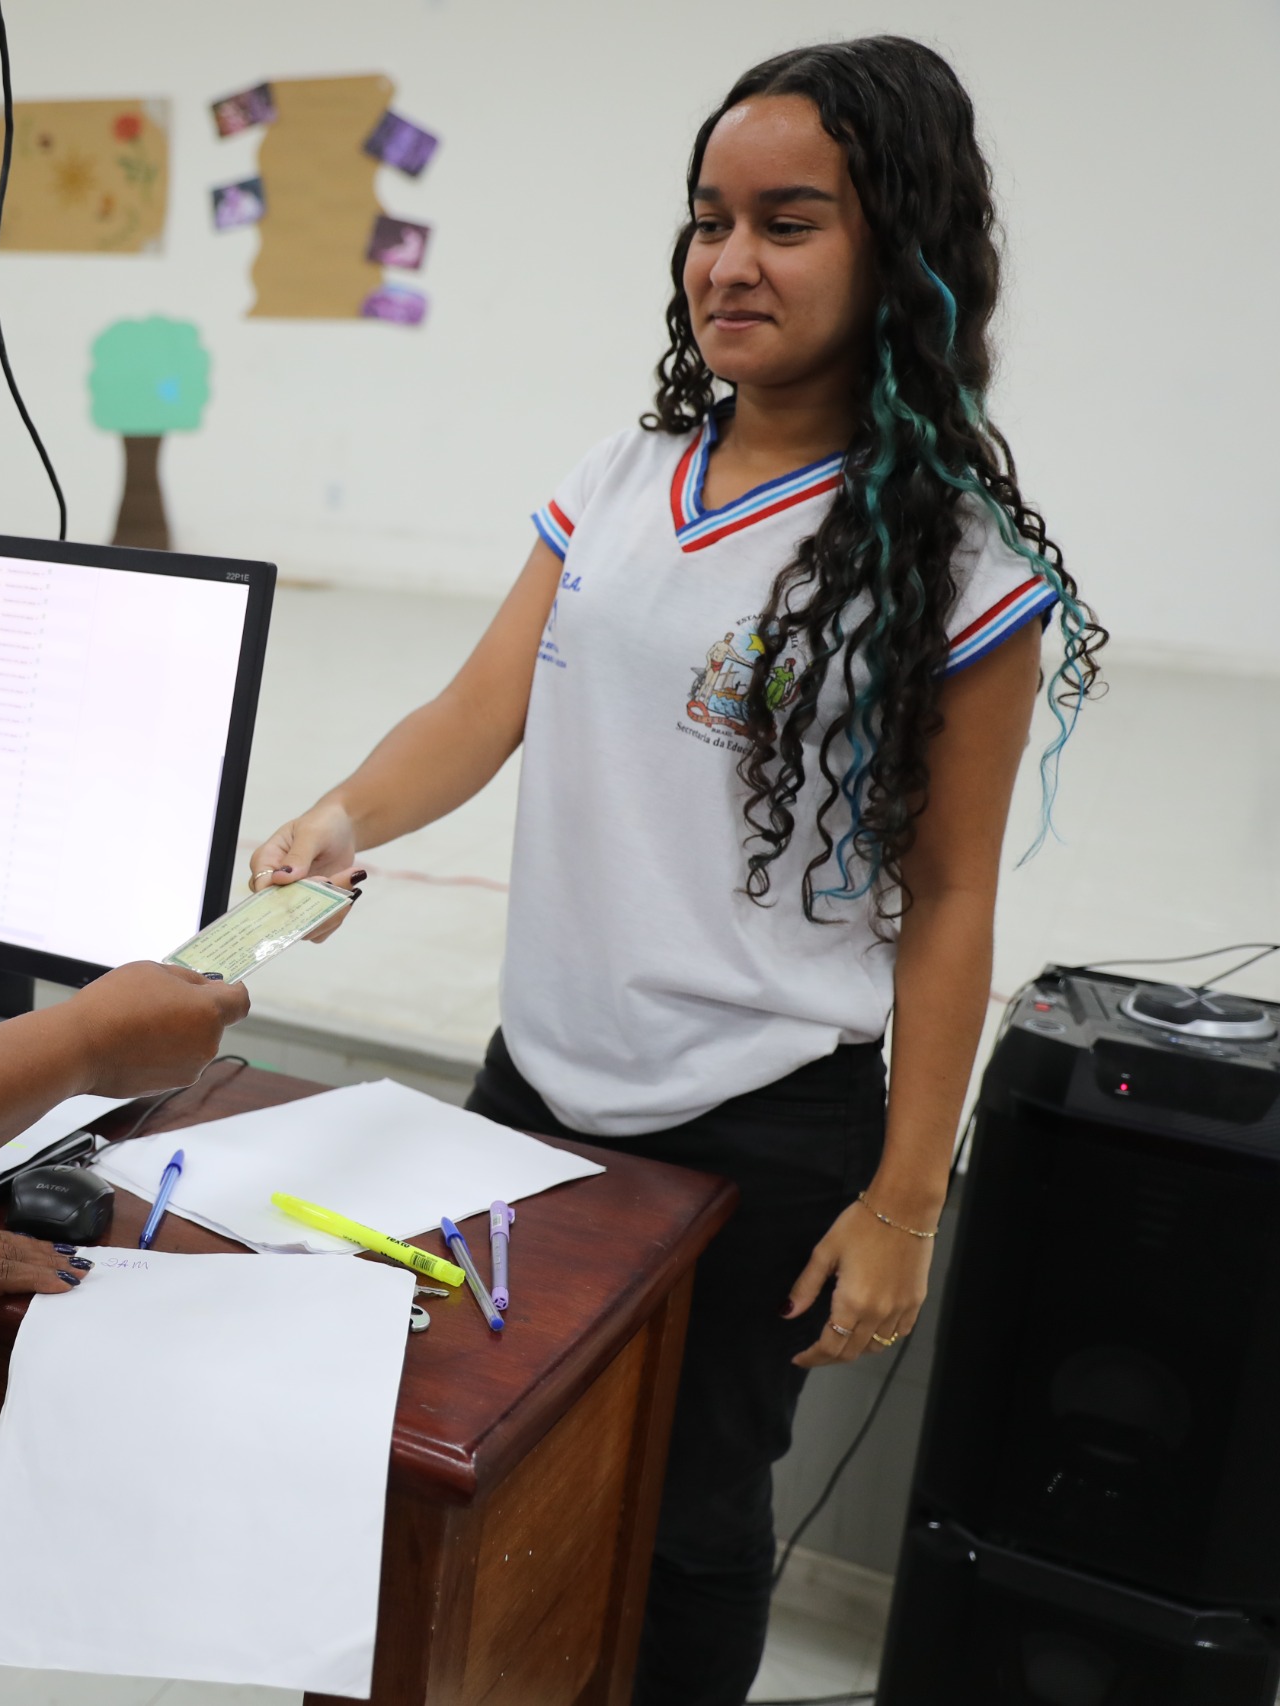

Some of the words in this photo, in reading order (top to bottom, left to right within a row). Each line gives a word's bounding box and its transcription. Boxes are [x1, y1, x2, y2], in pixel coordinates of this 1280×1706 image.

[225, 571, 250, 582] 22P1E
[676, 720, 711, 744] Secretaria
[712, 737, 725, 748] da
[726, 740, 748, 755] Educ
[36, 1183, 70, 1193] DATEN
